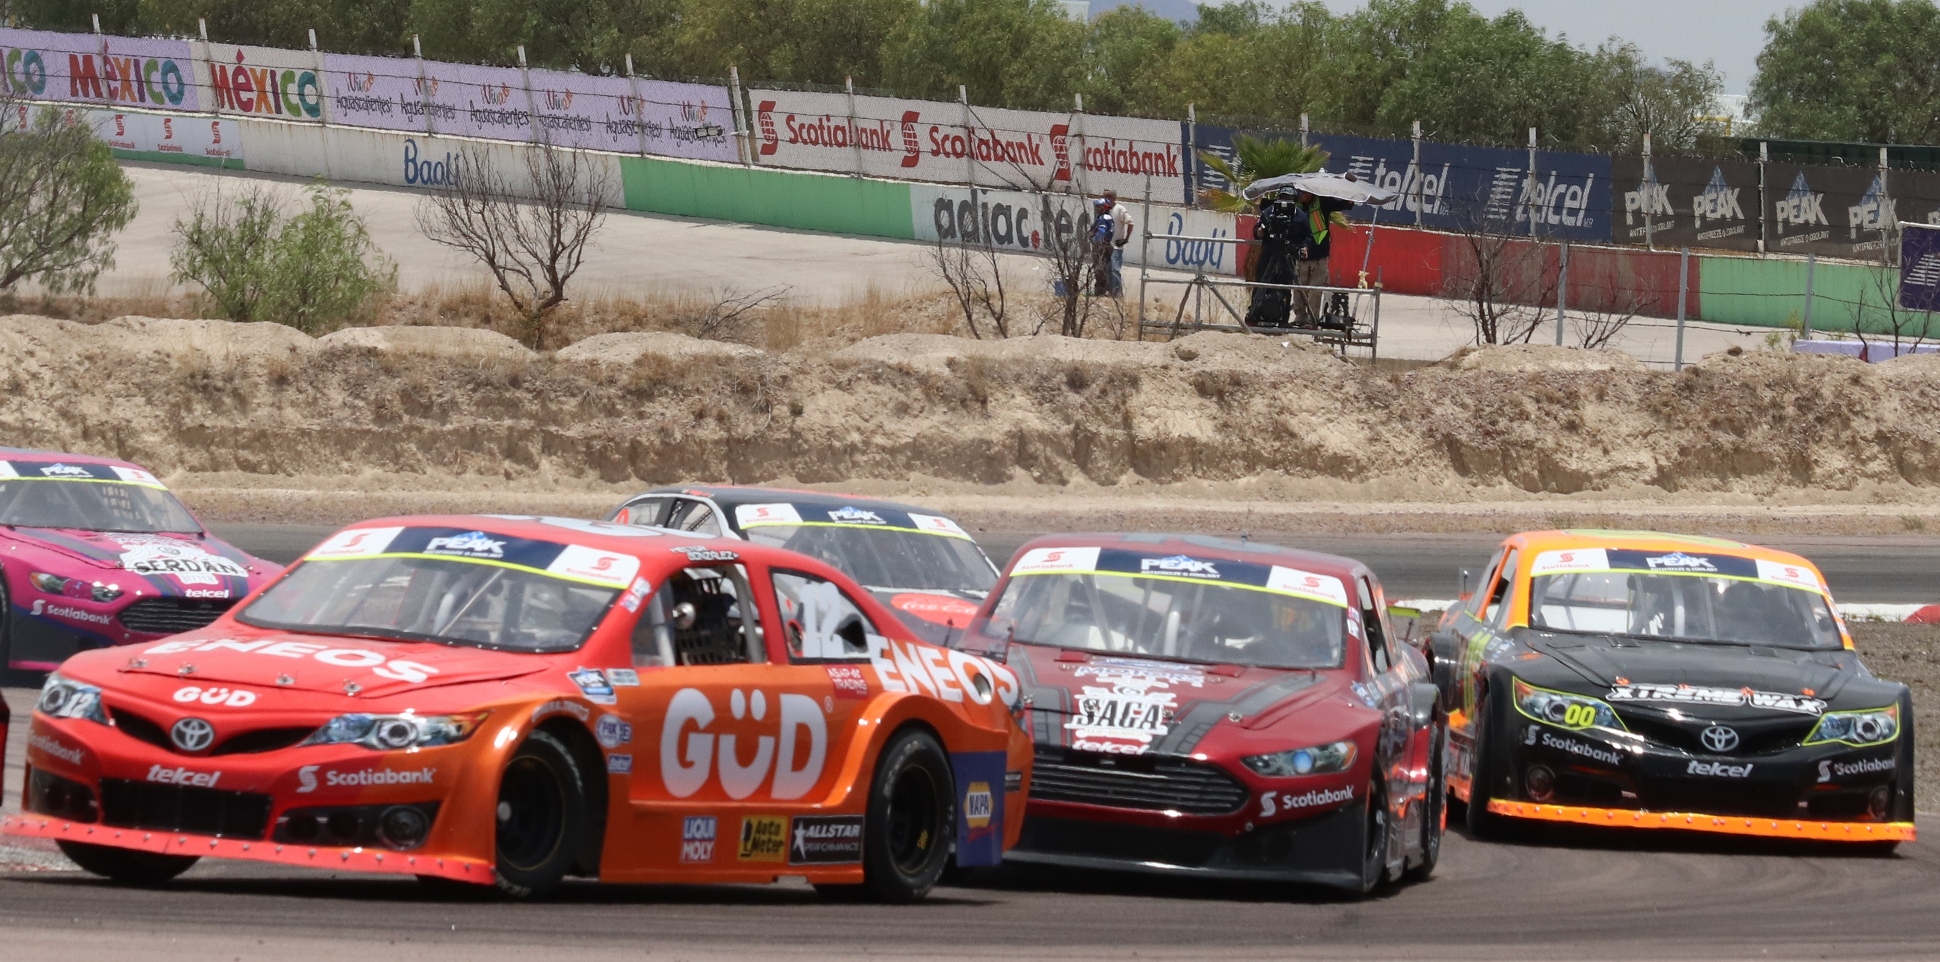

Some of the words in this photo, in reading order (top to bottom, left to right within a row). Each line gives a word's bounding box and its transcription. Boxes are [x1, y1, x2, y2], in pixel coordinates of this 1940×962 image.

[1082, 138, 1179, 178] cotiabank
[1693, 188, 1745, 229] PEAK
[1775, 193, 1829, 234] PEAK
[828, 509, 884, 522] PEAK
[427, 536, 507, 554] PEAK
[1141, 559, 1219, 574] PEAK
[1646, 556, 1718, 568] PEAK
[186, 588, 230, 599] telcel
[47, 604, 110, 625] Scotiabank
[143, 637, 440, 683] ENEOS
[866, 634, 1019, 707] ENEOS
[60, 692, 94, 718] 12
[172, 686, 256, 707] GÜD
[1610, 685, 1744, 704] XTREME
[1753, 692, 1824, 713] WAX
[1077, 698, 1160, 730] SAGA
[1564, 703, 1597, 727] 00
[660, 687, 828, 801] GÜD
[1072, 740, 1151, 755] telcel
[1542, 733, 1620, 766] Scotiabank
[147, 764, 221, 788] telcel
[326, 767, 434, 787] Scotiabank
[1687, 759, 1753, 778] telcel
[969, 794, 989, 815] NAPA
[1283, 785, 1353, 810] Scotiabank
[684, 818, 716, 838] LIQUI
[805, 824, 861, 839] ALLSTAR
[683, 842, 714, 861] MOLY
